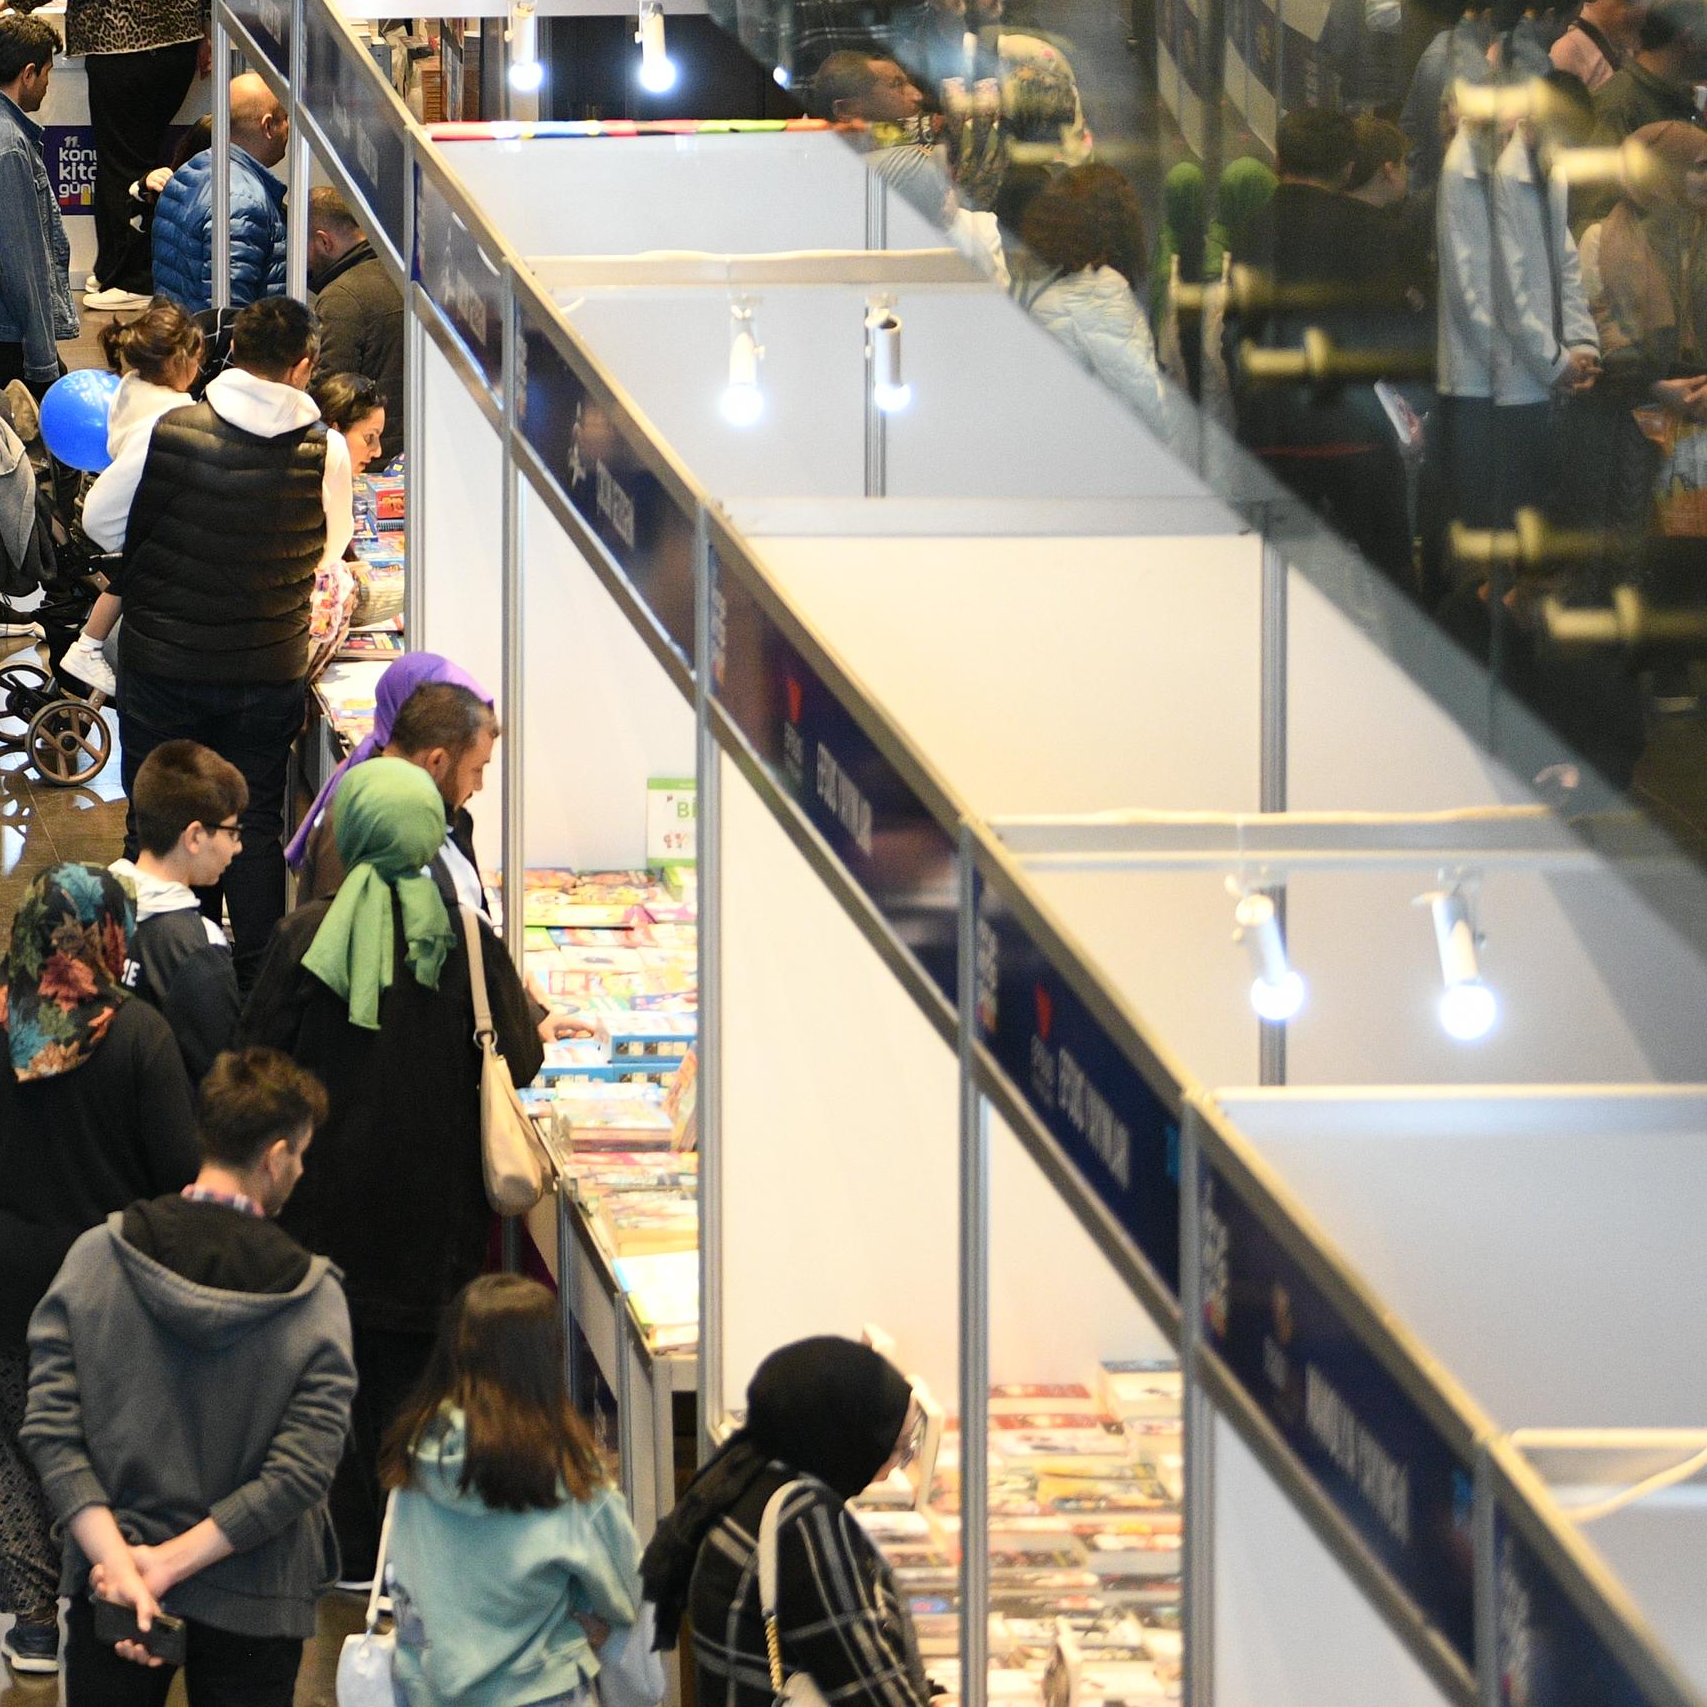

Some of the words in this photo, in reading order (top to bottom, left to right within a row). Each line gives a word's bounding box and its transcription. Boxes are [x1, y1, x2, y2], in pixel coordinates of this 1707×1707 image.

[64, 136, 80, 148] 11.
[59, 147, 97, 162] kon
[59, 181, 95, 199] günl
